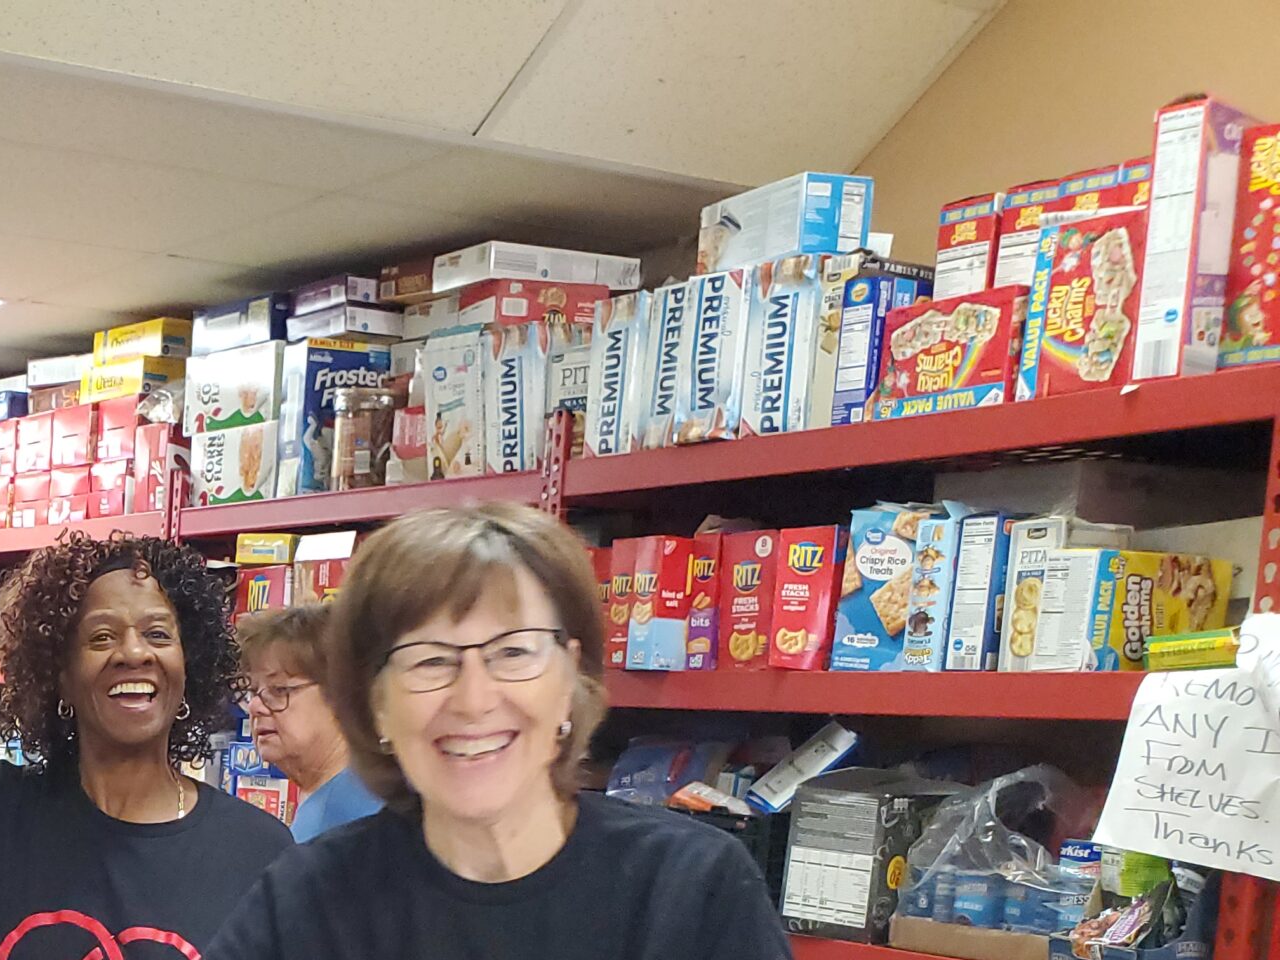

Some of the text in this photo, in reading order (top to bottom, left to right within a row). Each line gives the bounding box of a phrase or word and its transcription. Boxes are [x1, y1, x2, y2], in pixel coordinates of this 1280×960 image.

[1022, 269, 1049, 371] VALUE PACK
[1044, 285, 1071, 337] Lucky
[1064, 276, 1092, 342] Charms
[656, 286, 686, 416] PREMIUM
[698, 274, 726, 410] PREMIUM
[760, 293, 790, 434] PREMIUM
[915, 346, 962, 373] Charms
[561, 366, 590, 386] PIT
[916, 367, 954, 393] Lucky
[598, 329, 622, 455] PREMIUM
[902, 391, 976, 416] VALUE PACK
[500, 357, 518, 473] PREMIUM
[205, 436, 218, 483] CORN
[214, 433, 226, 481] FLAKES
[788, 543, 824, 568] RITZ
[860, 555, 907, 568] Crispy Rice
[870, 547, 897, 556] Original
[1020, 550, 1048, 565] PITA
[693, 559, 716, 577] RITZ
[733, 563, 762, 588] RITZ
[869, 567, 893, 576] Treats
[247, 578, 271, 611] RITZ
[599, 583, 610, 601] RIT
[612, 576, 632, 592] RITZ
[634, 573, 658, 593] RITZ
[784, 583, 809, 591] FRESH
[732, 604, 759, 613] STACKS
[734, 596, 758, 605] FRESH
[1141, 577, 1153, 639] ahams
[690, 617, 711, 627] bits
[1091, 580, 1113, 649] VALUE PACK
[1122, 574, 1144, 661] Golden
[1140, 705, 1229, 748] ANY
[1142, 740, 1227, 781] FROM
[1124, 806, 1273, 866] Thanks
